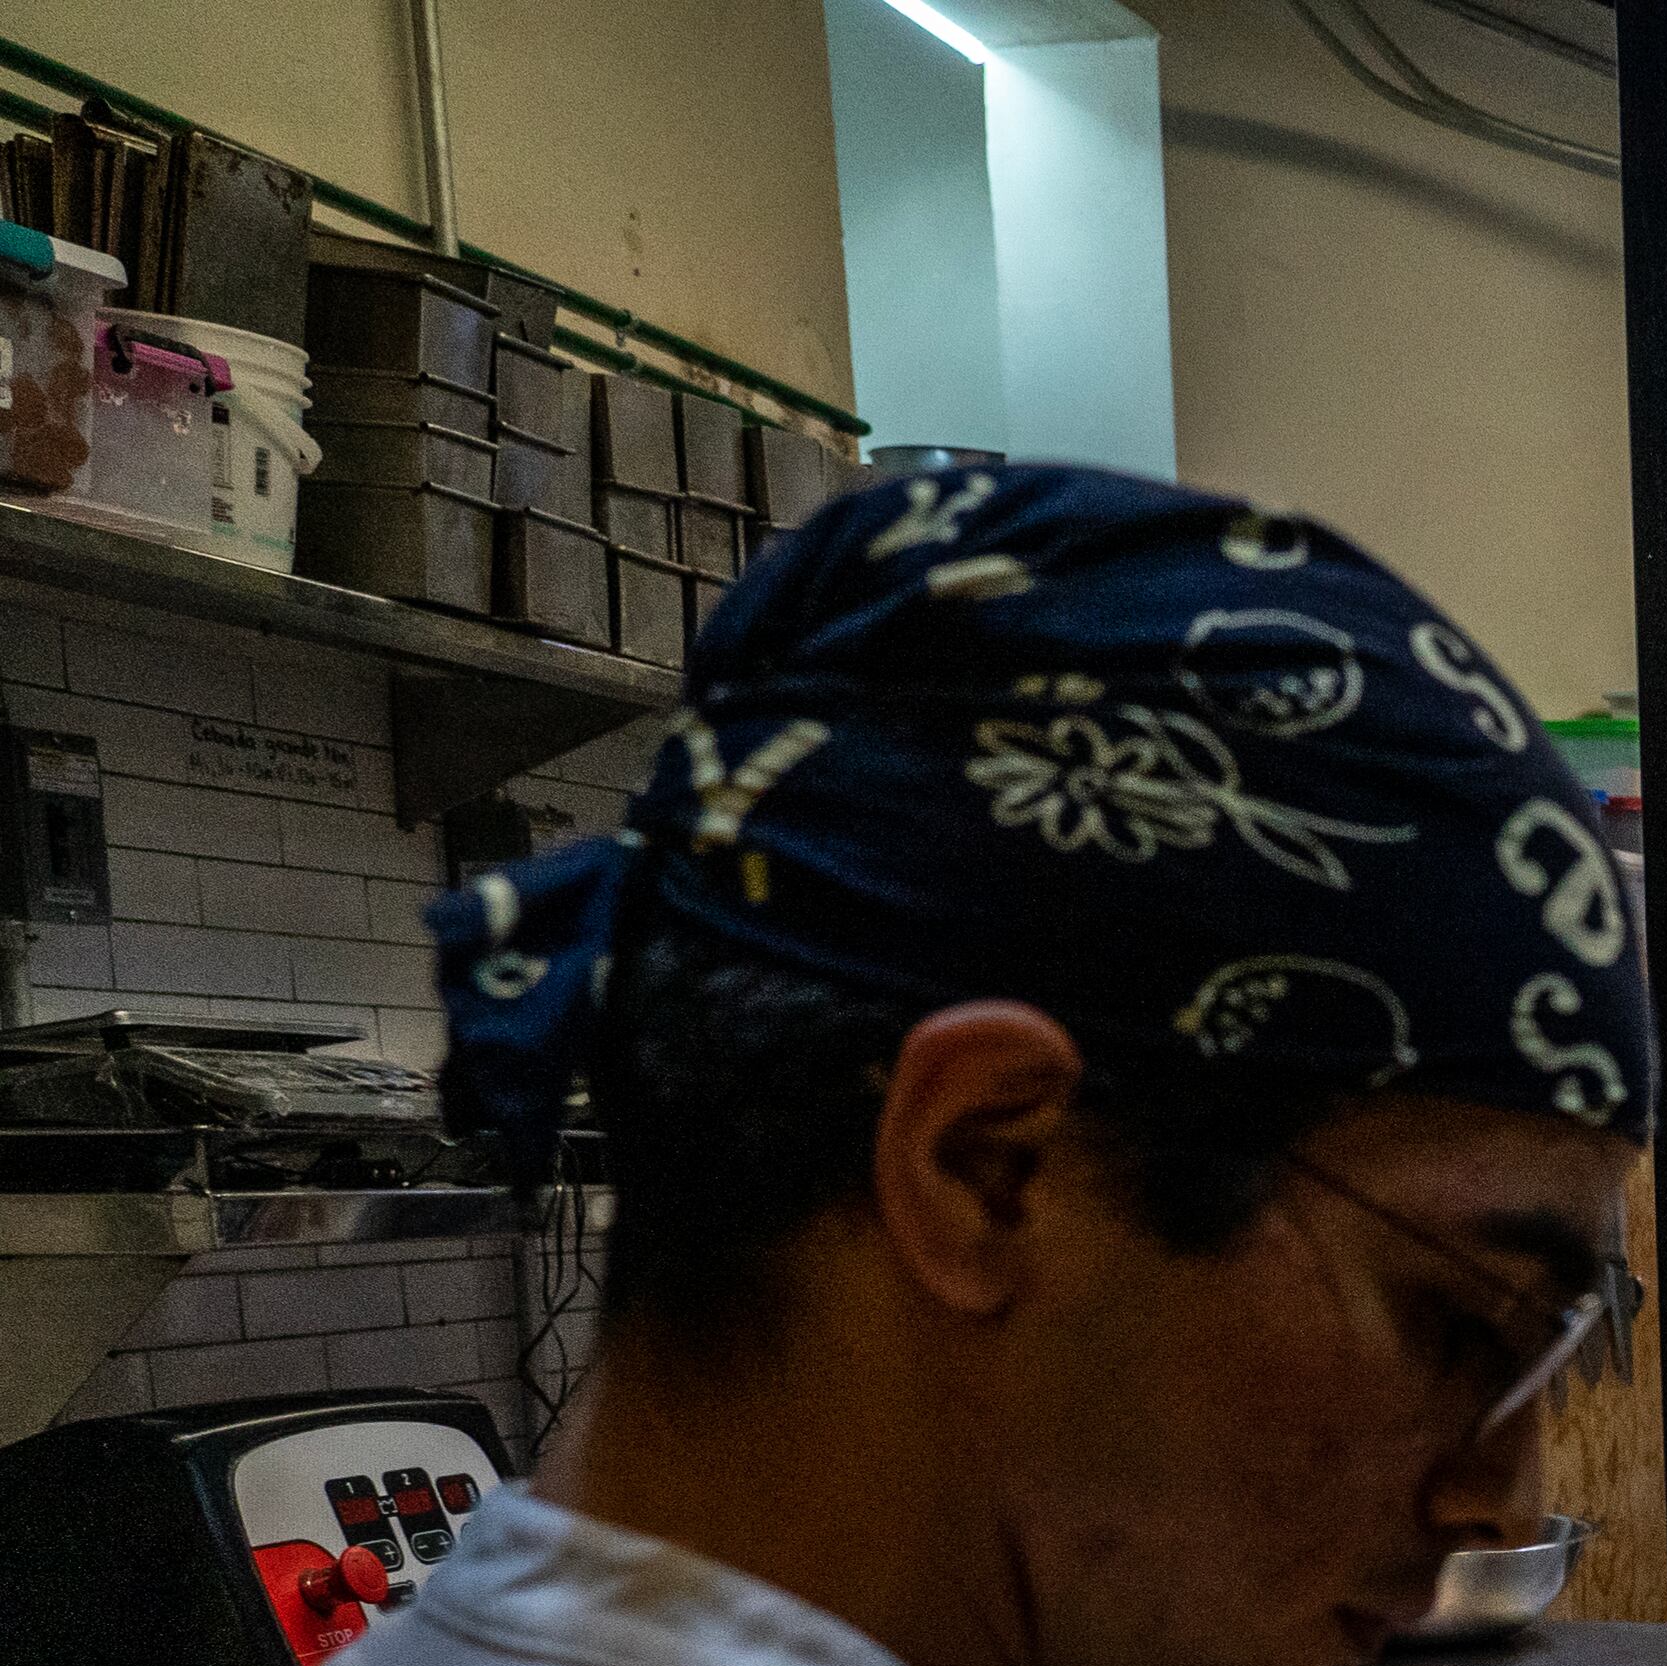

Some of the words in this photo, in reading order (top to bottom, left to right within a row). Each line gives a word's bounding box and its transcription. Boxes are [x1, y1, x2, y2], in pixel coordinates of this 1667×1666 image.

[400, 1473, 412, 1486] 2
[345, 1482, 355, 1494] 1
[317, 1628, 354, 1648] STOP
